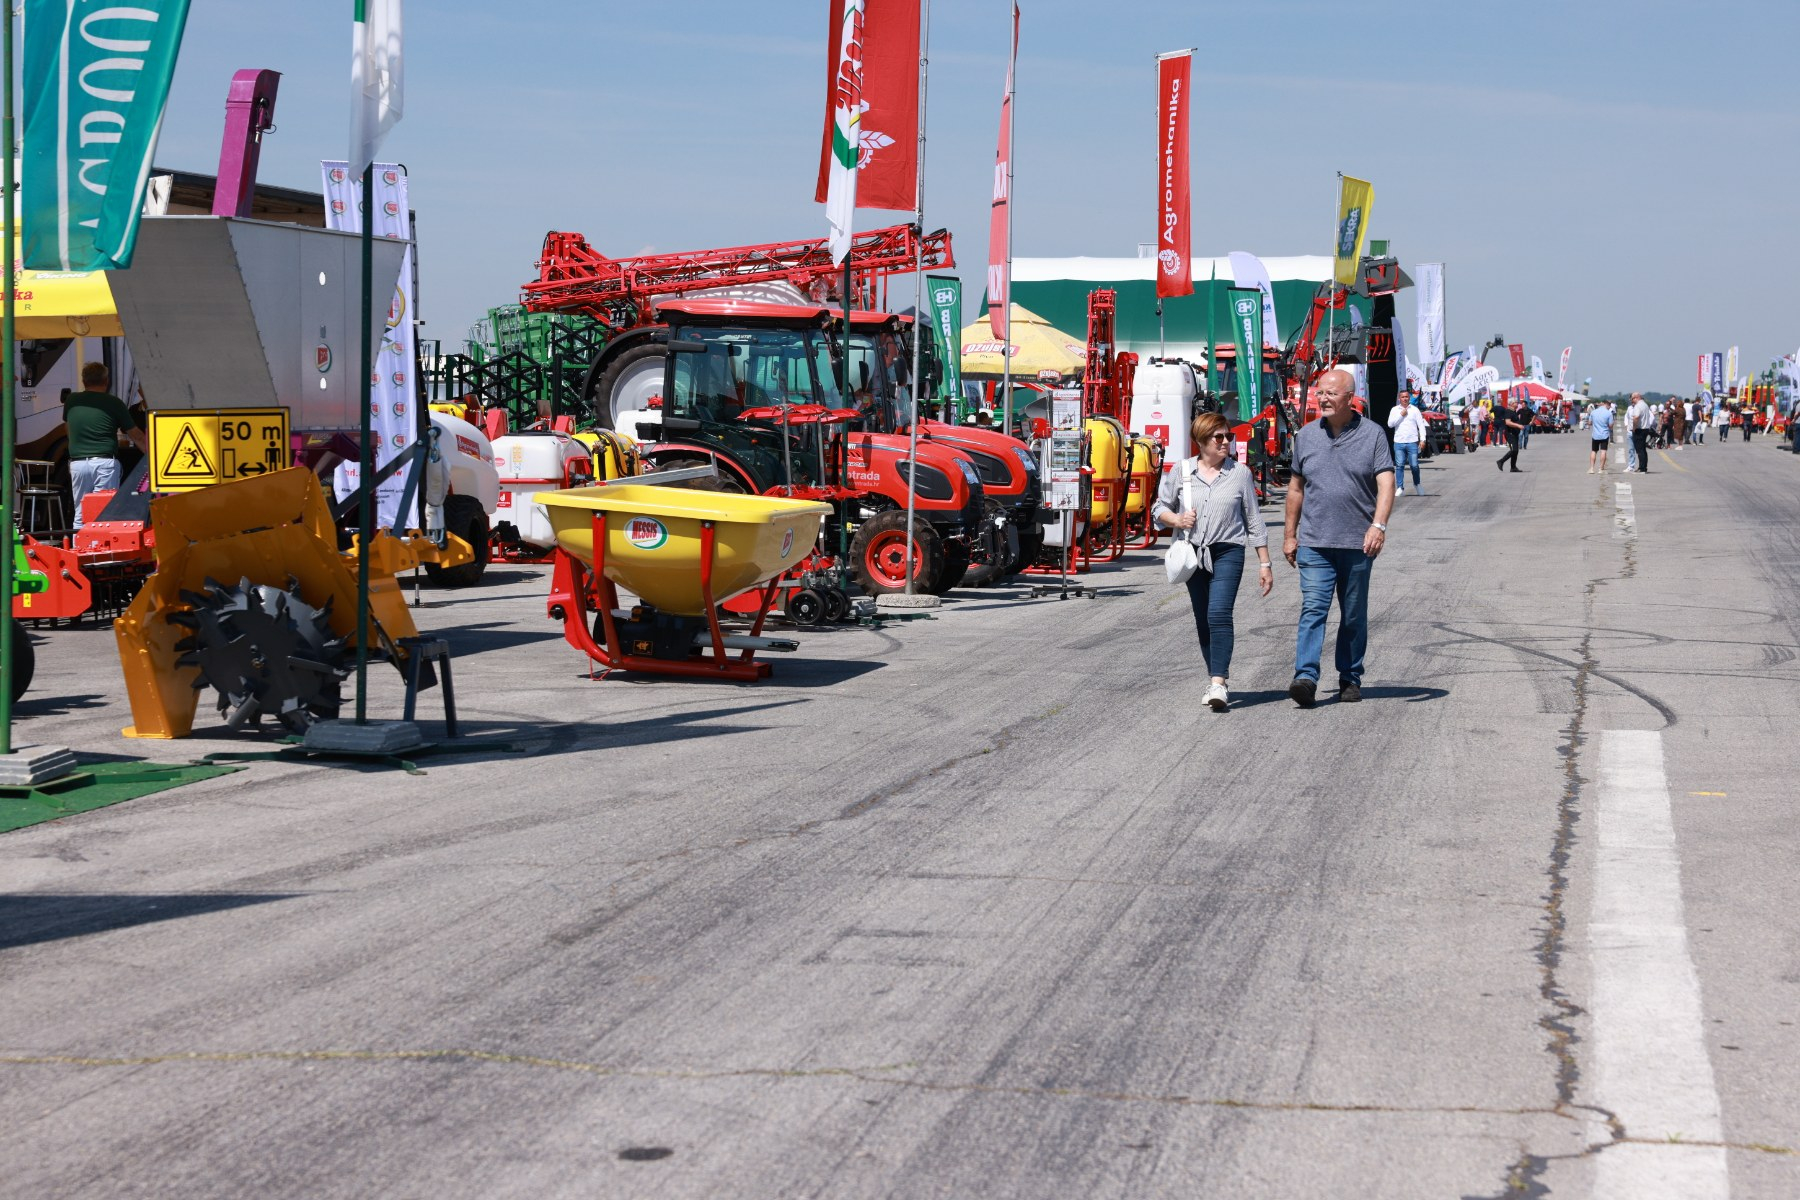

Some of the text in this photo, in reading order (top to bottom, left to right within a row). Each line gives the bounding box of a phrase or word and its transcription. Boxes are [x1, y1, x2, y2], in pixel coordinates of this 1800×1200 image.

[1163, 78, 1180, 245] Agromehanika
[1342, 208, 1360, 252] SEKRA
[1466, 374, 1495, 394] START
[1473, 370, 1494, 382] Agro
[221, 421, 281, 441] 50 m
[632, 520, 658, 540] MESSIS
